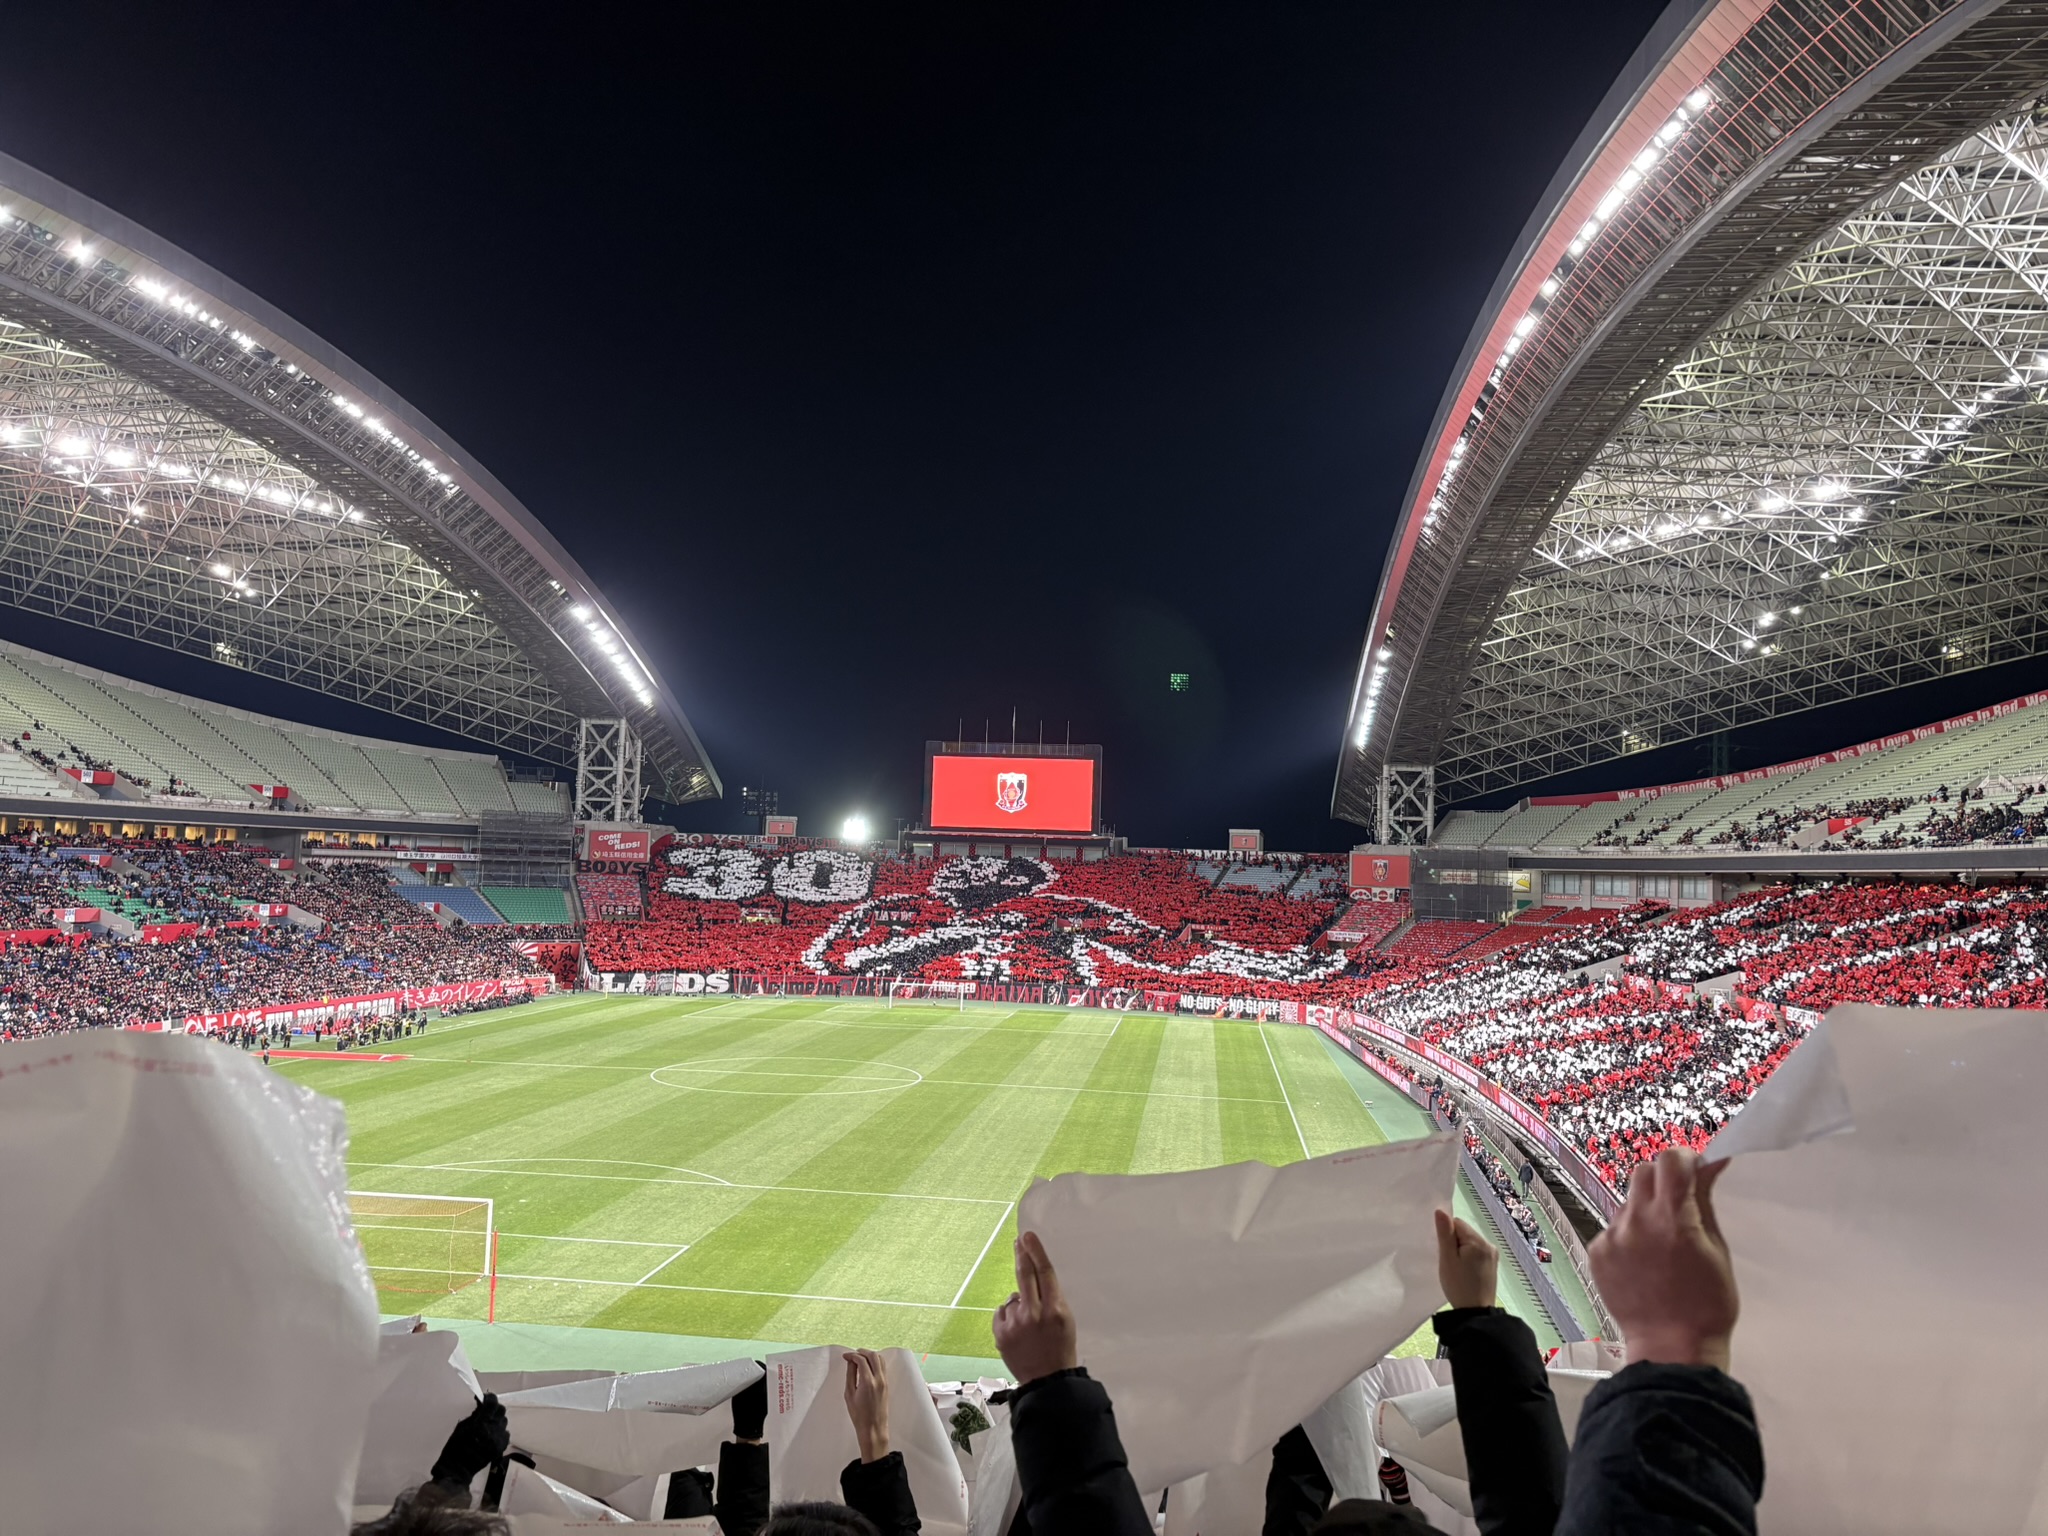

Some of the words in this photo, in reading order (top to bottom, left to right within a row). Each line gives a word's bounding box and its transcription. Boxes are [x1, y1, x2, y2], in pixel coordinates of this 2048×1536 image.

[1617, 790, 1637, 802] We
[1638, 788, 1658, 800] Are
[1660, 779, 1718, 797] Diamonds
[1721, 774, 1741, 789] We
[1744, 771, 1765, 782] Are
[1766, 755, 1827, 779] Diamonds
[1832, 749, 1854, 763] Yes
[1857, 742, 1878, 757] We
[1880, 733, 1910, 750] Love
[1912, 727, 1937, 741] You
[1942, 715, 1974, 733] Boys
[1977, 709, 1991, 722] In
[1993, 699, 2019, 718] Red
[2024, 693, 2048, 707] We
[598, 832, 622, 841] COME
[614, 841, 640, 851] REDS!
[1181, 994, 1195, 1008] NO
[1196, 996, 1223, 1011] GUTS
[1229, 998, 1244, 1012] NO
[1249, 999, 1279, 1015] GLORY
